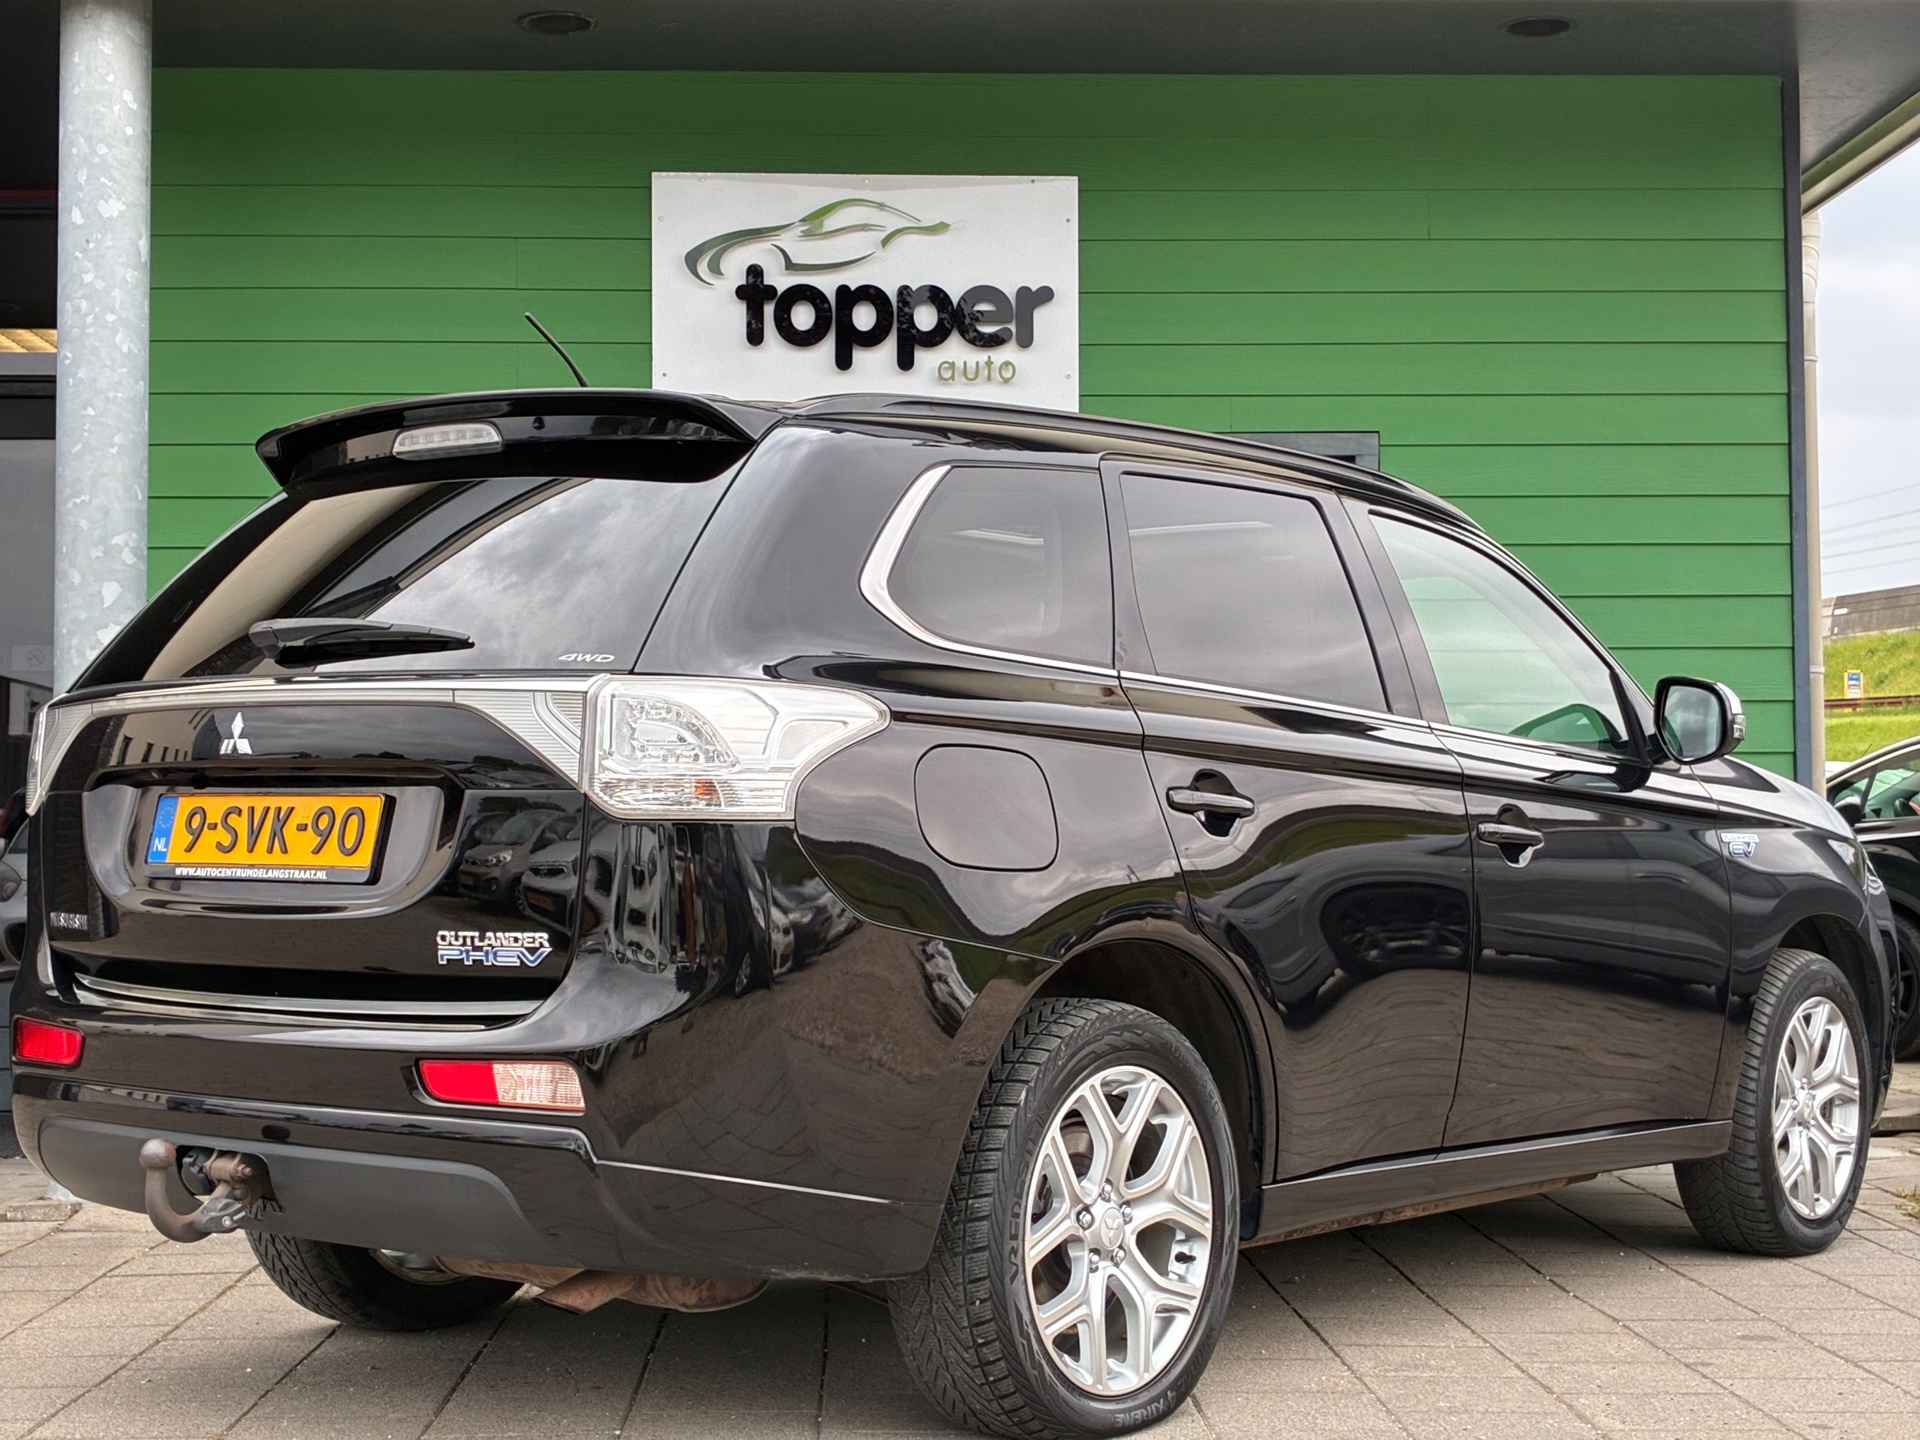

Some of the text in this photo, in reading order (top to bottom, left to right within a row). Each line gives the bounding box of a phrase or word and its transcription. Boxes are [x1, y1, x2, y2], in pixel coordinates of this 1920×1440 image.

[735, 263, 1055, 371] topper
[937, 355, 1017, 383] auto
[557, 652, 616, 663] 4WD
[184, 805, 366, 857] 9-SVK-90
[153, 837, 168, 852] NL
[175, 866, 328, 880] WWW.AUTOCENTRUMDELANGSTRAAT.NL
[436, 930, 550, 948] OUTLANDER
[437, 945, 553, 968] PHEV
